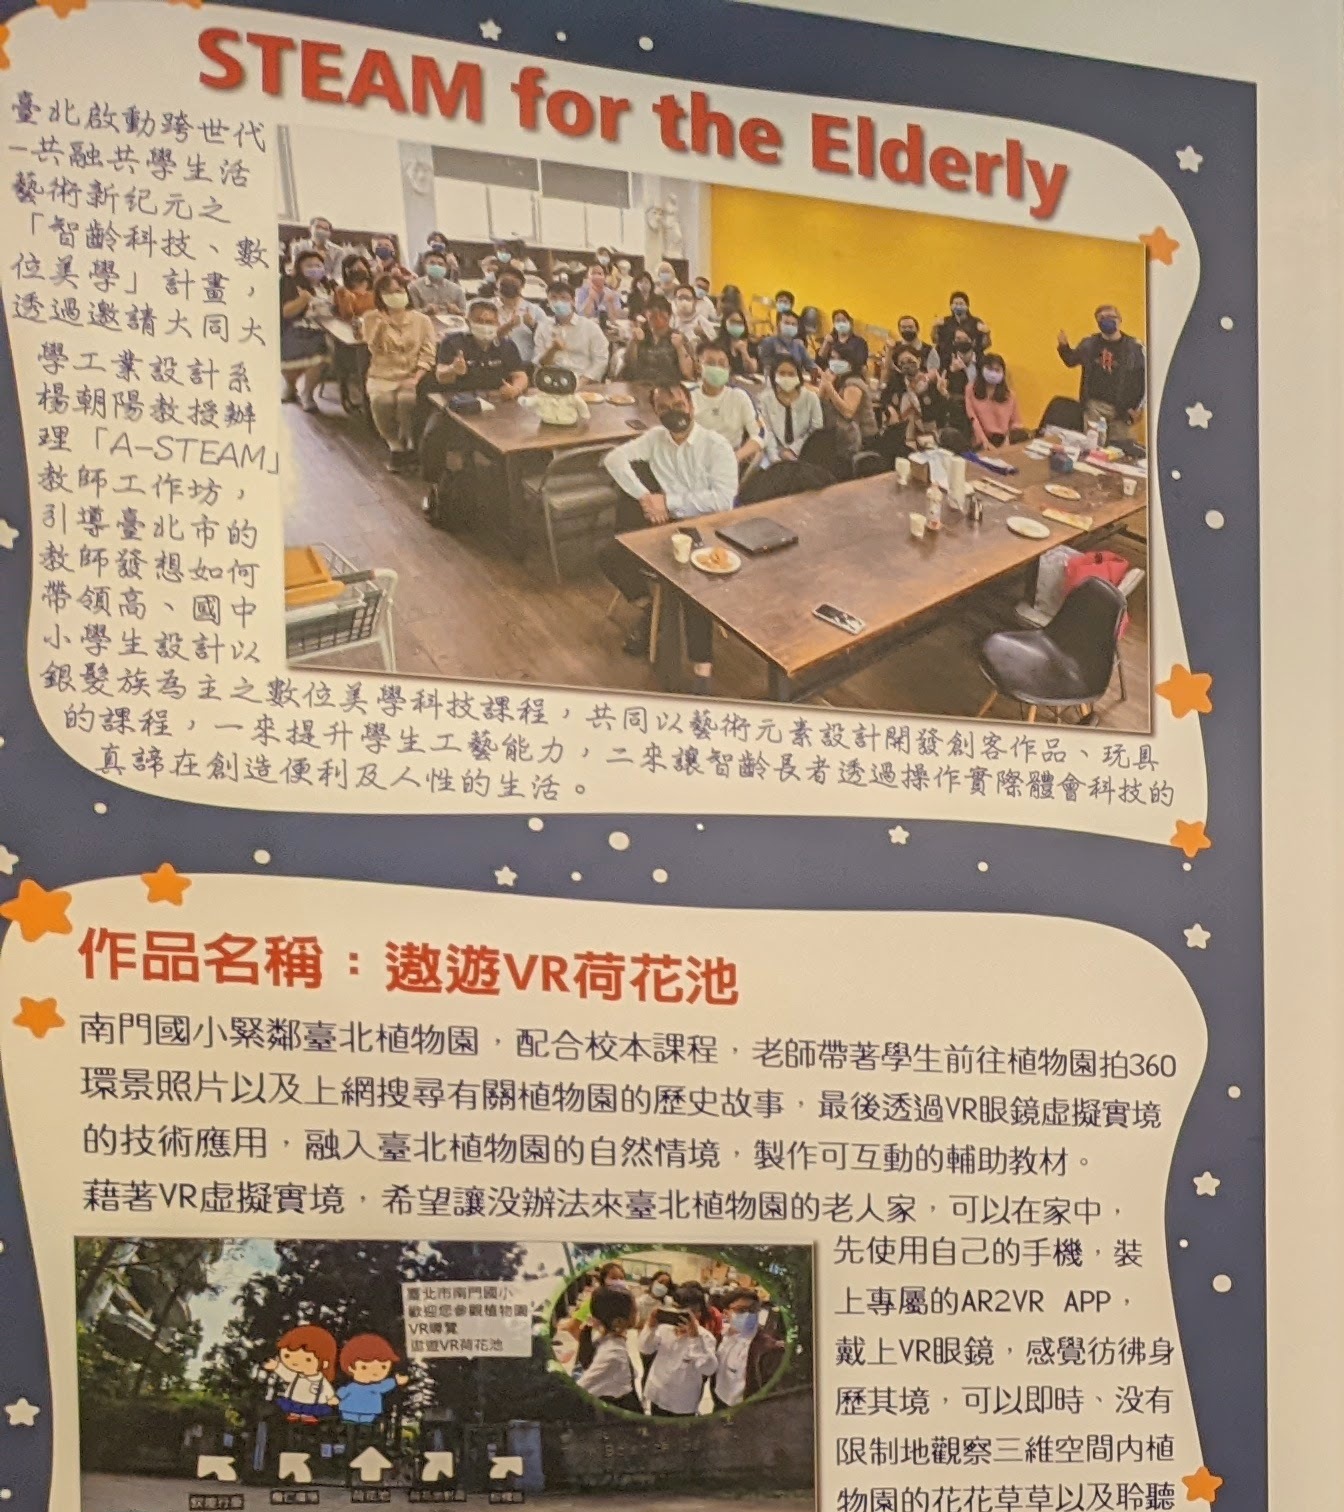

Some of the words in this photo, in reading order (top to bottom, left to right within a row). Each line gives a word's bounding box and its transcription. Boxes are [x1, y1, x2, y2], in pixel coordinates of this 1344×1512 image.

[199, 27, 484, 123] STEAM
[510, 66, 630, 142] for
[653, 91, 781, 165] the
[811, 113, 1068, 220] Elderly
[11, 292, 266, 347] 透過邀請大同大
[38, 342, 252, 393] 學工業設計系
[37, 381, 257, 433] 楊朝陽教授辦
[42, 503, 258, 549] 引導臺北市的
[38, 543, 261, 588] 教師發想如何
[42, 627, 261, 666] 小學生設計以
[78, 926, 740, 1006] 作品名稱：遨遊VR荷花池
[834, 1234, 1143, 1270] 先使用自己的手機，裝
[835, 1286, 1044, 1316] 上專屬的AR2VR
